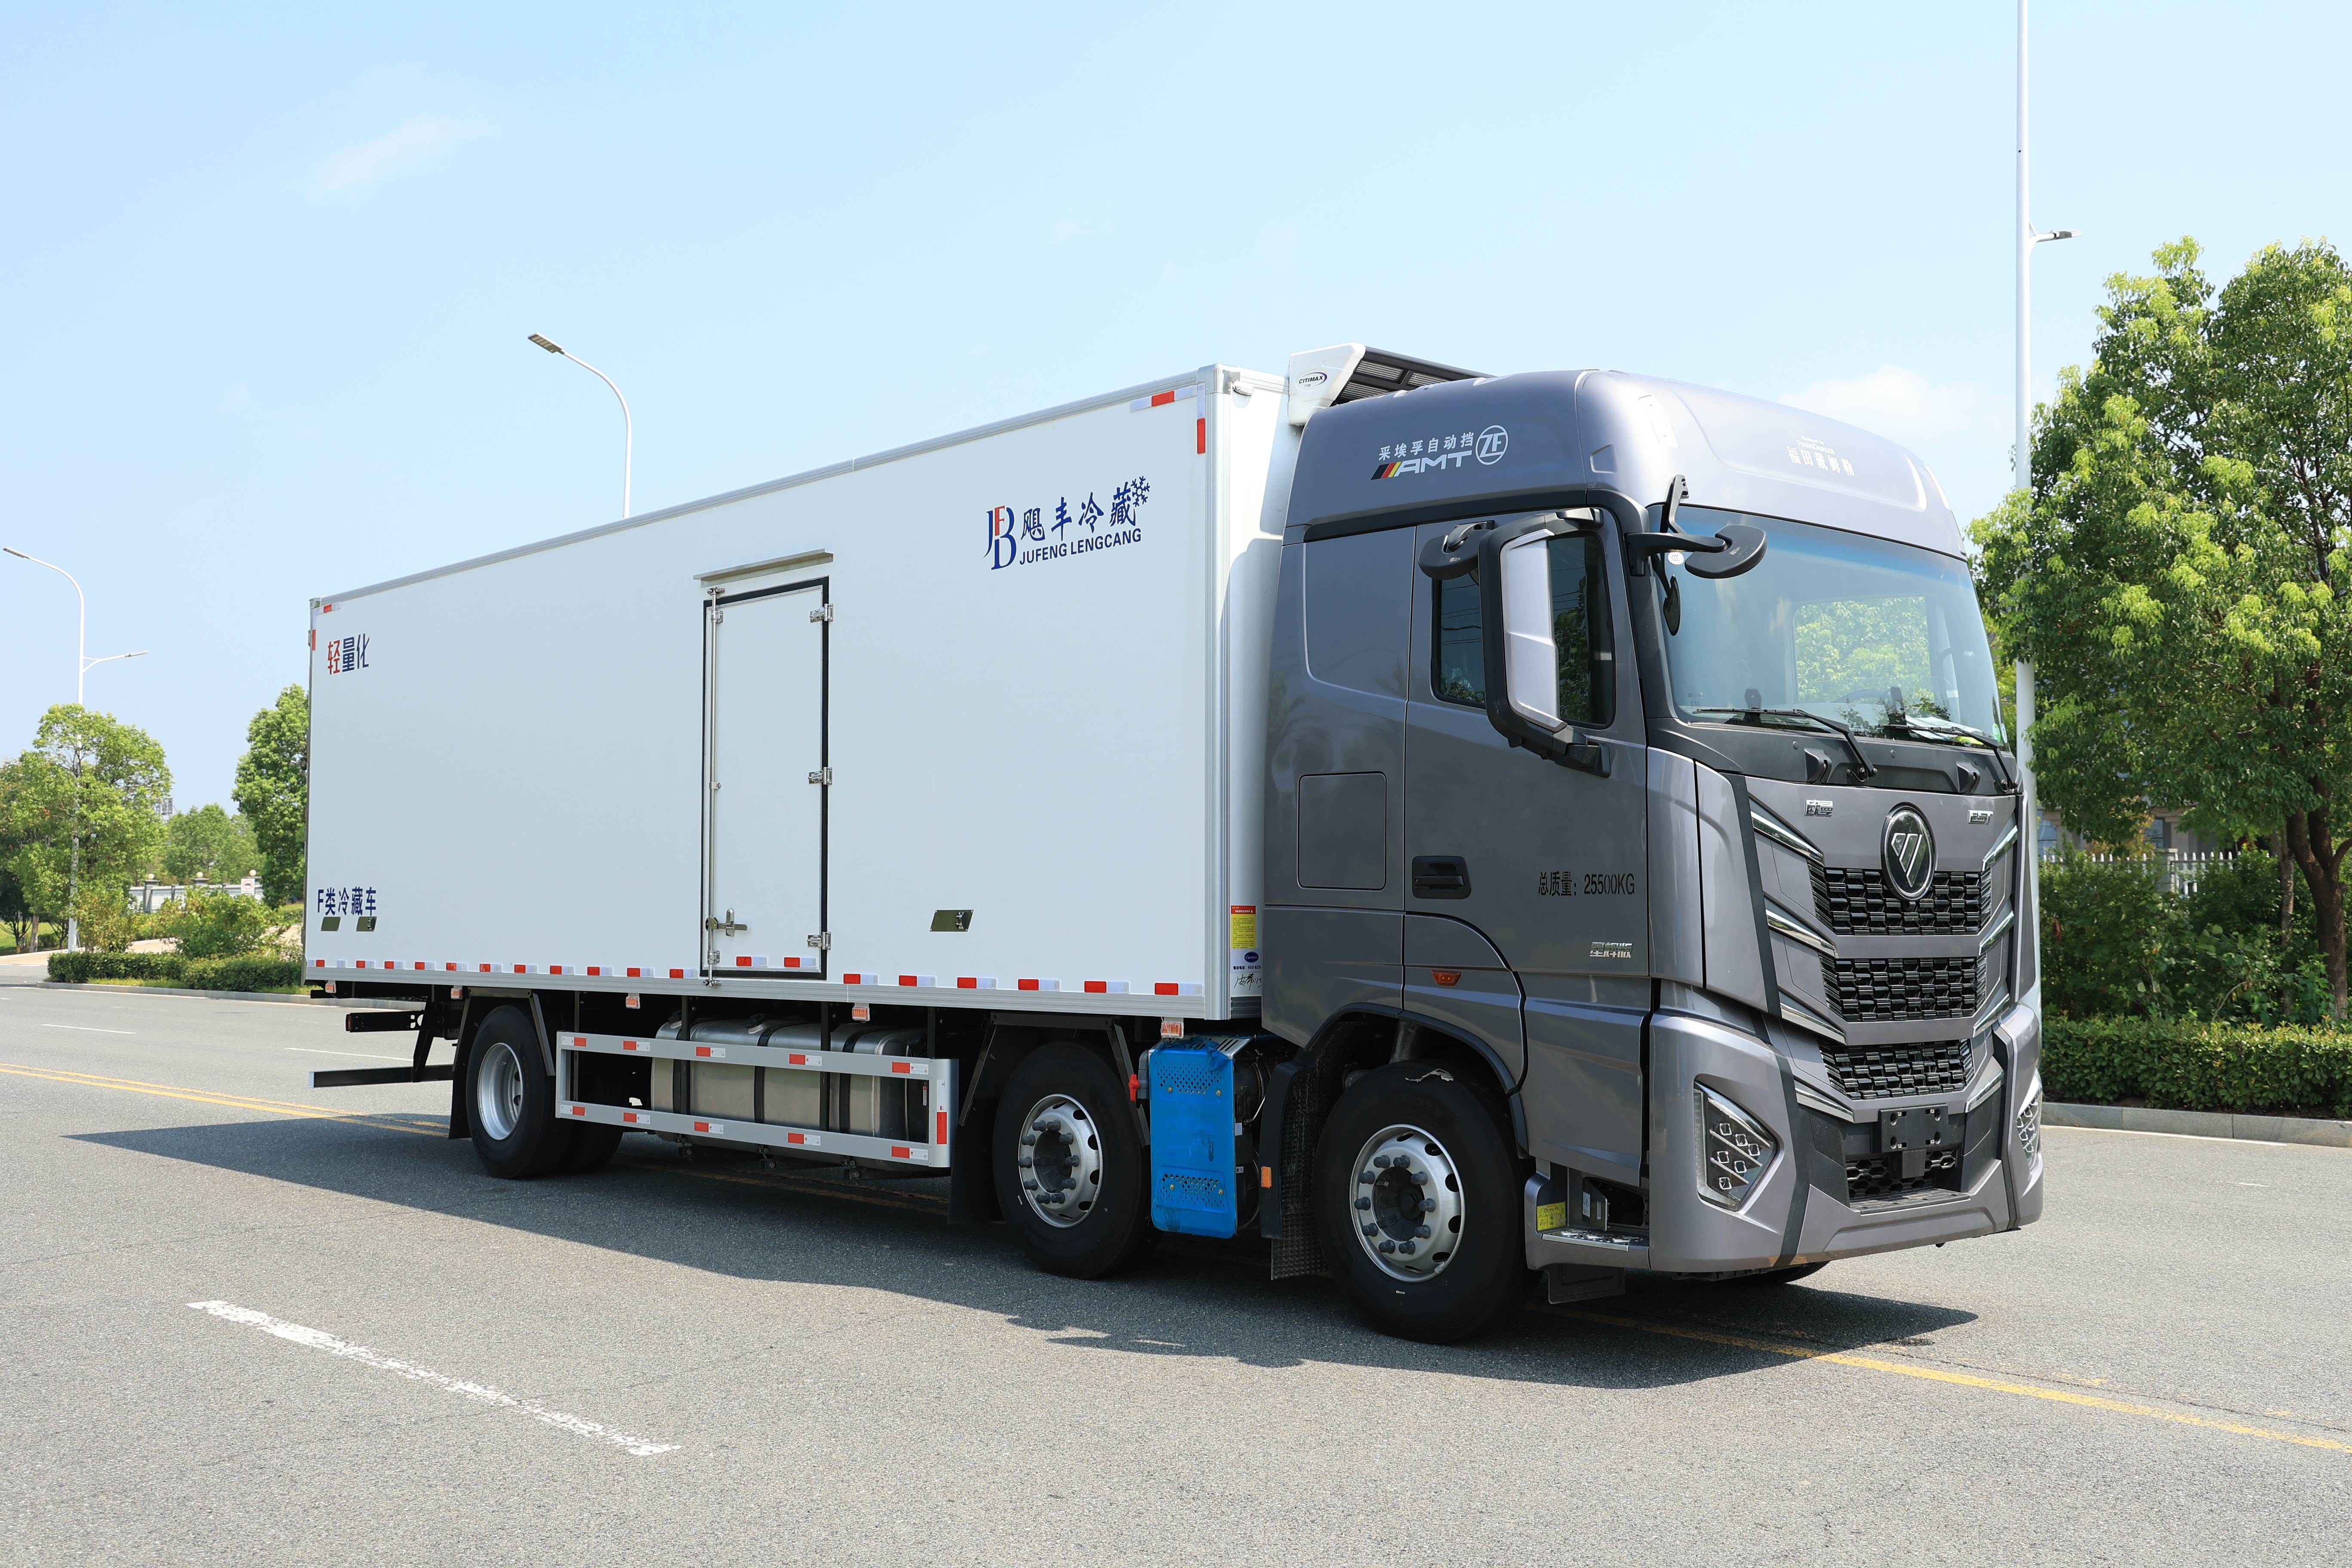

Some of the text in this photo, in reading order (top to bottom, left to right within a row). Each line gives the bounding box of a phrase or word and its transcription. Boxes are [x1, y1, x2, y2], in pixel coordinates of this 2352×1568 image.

[1299, 375, 1323, 384] CITIMAX
[1378, 432, 1475, 461] 采埃孚自动挡
[1477, 431, 1507, 459] ZF
[1394, 450, 1472, 477] AMT
[1786, 445, 1855, 476] 福田戴姆勒
[1019, 528, 1142, 565] JUFENG LENGCANG
[328, 633, 370, 675] 轻量化
[317, 886, 377, 916] F类冷藏车
